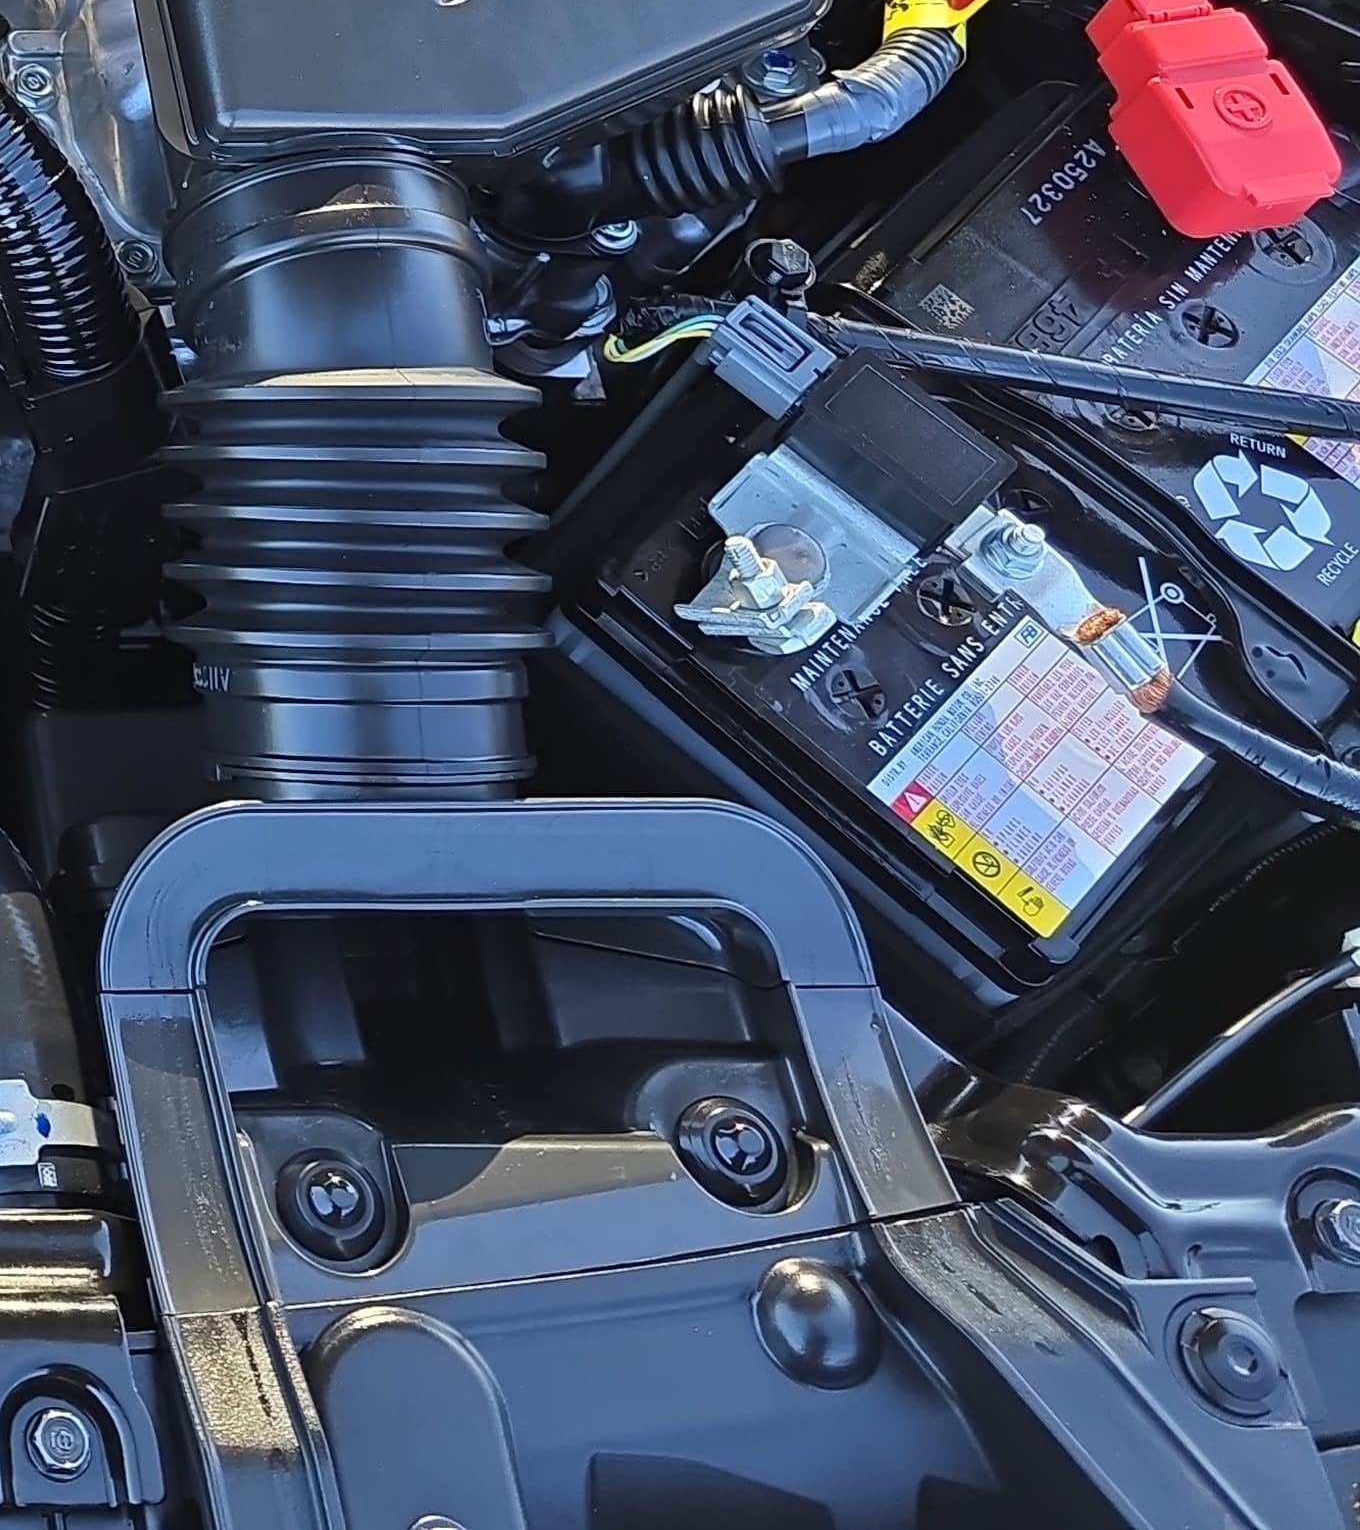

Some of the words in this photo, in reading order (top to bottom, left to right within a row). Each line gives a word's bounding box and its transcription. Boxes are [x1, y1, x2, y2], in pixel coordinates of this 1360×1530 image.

[1020, 136, 1106, 226] A250327
[1158, 280, 1188, 311] SIN
[1230, 433, 1286, 459] RETURN
[1316, 541, 1360, 587] RECYCLE
[868, 677, 945, 758] BATTERIE
[941, 636, 985, 679] SANS
[909, 729, 935, 757] AMERICAN
[931, 713, 950, 733] HONDA
[946, 696, 965, 717] MOTOR
[940, 704, 973, 739] CALIFORNIA
